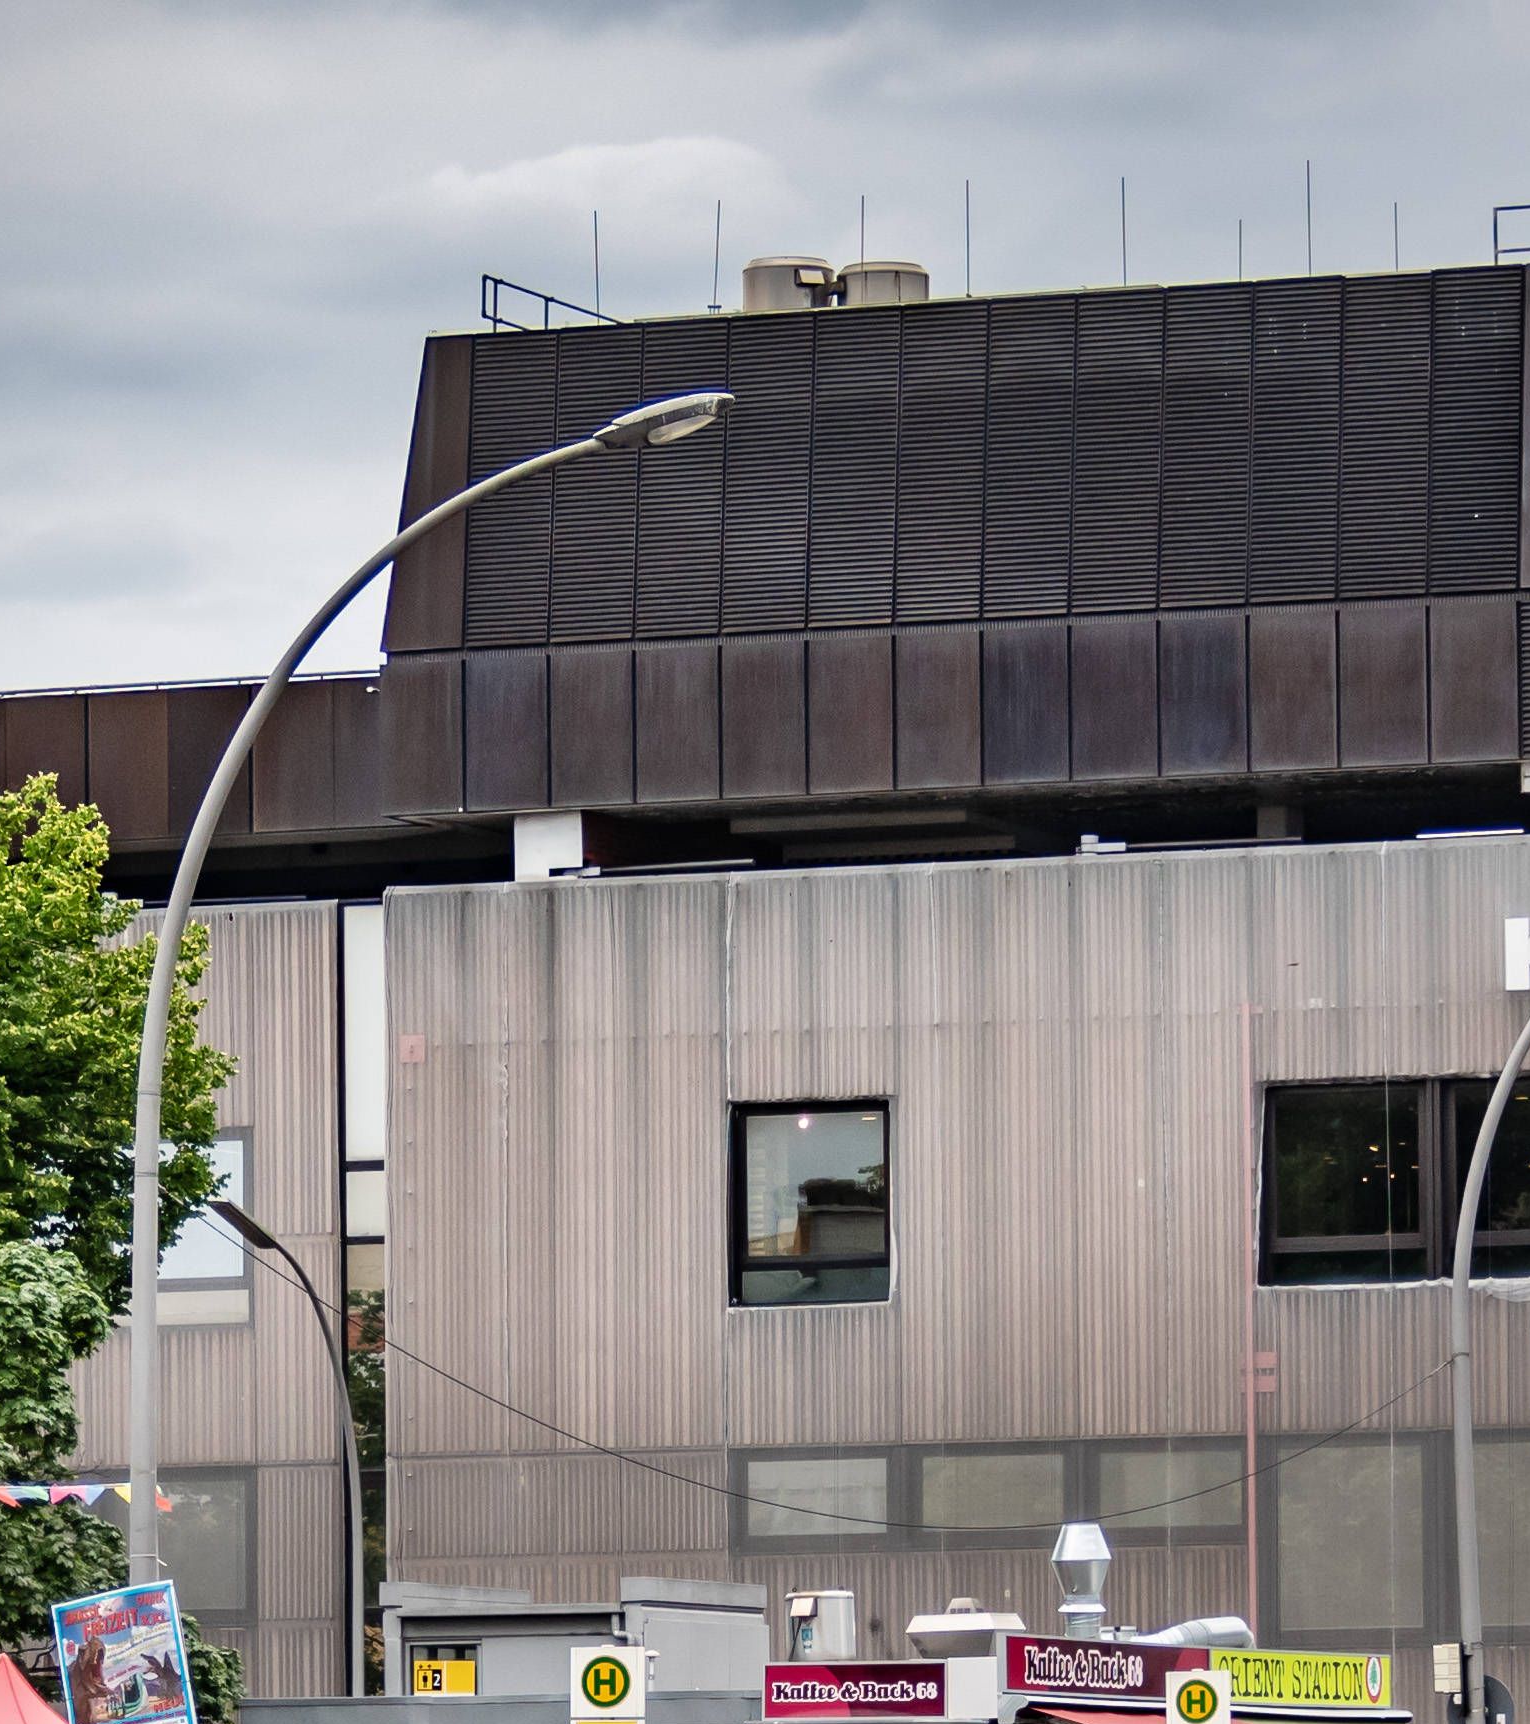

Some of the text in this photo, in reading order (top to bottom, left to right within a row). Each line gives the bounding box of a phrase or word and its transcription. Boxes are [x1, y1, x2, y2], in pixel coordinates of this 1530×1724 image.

[433, 1673, 441, 1687] 2
[1025, 1646, 1144, 1689] Kaffee & Back 68
[1292, 1660, 1364, 1700] STATION
[593, 1668, 616, 1696] H
[772, 1681, 938, 1702] Kaffee & Back 68
[1186, 1690, 1206, 1714] H
